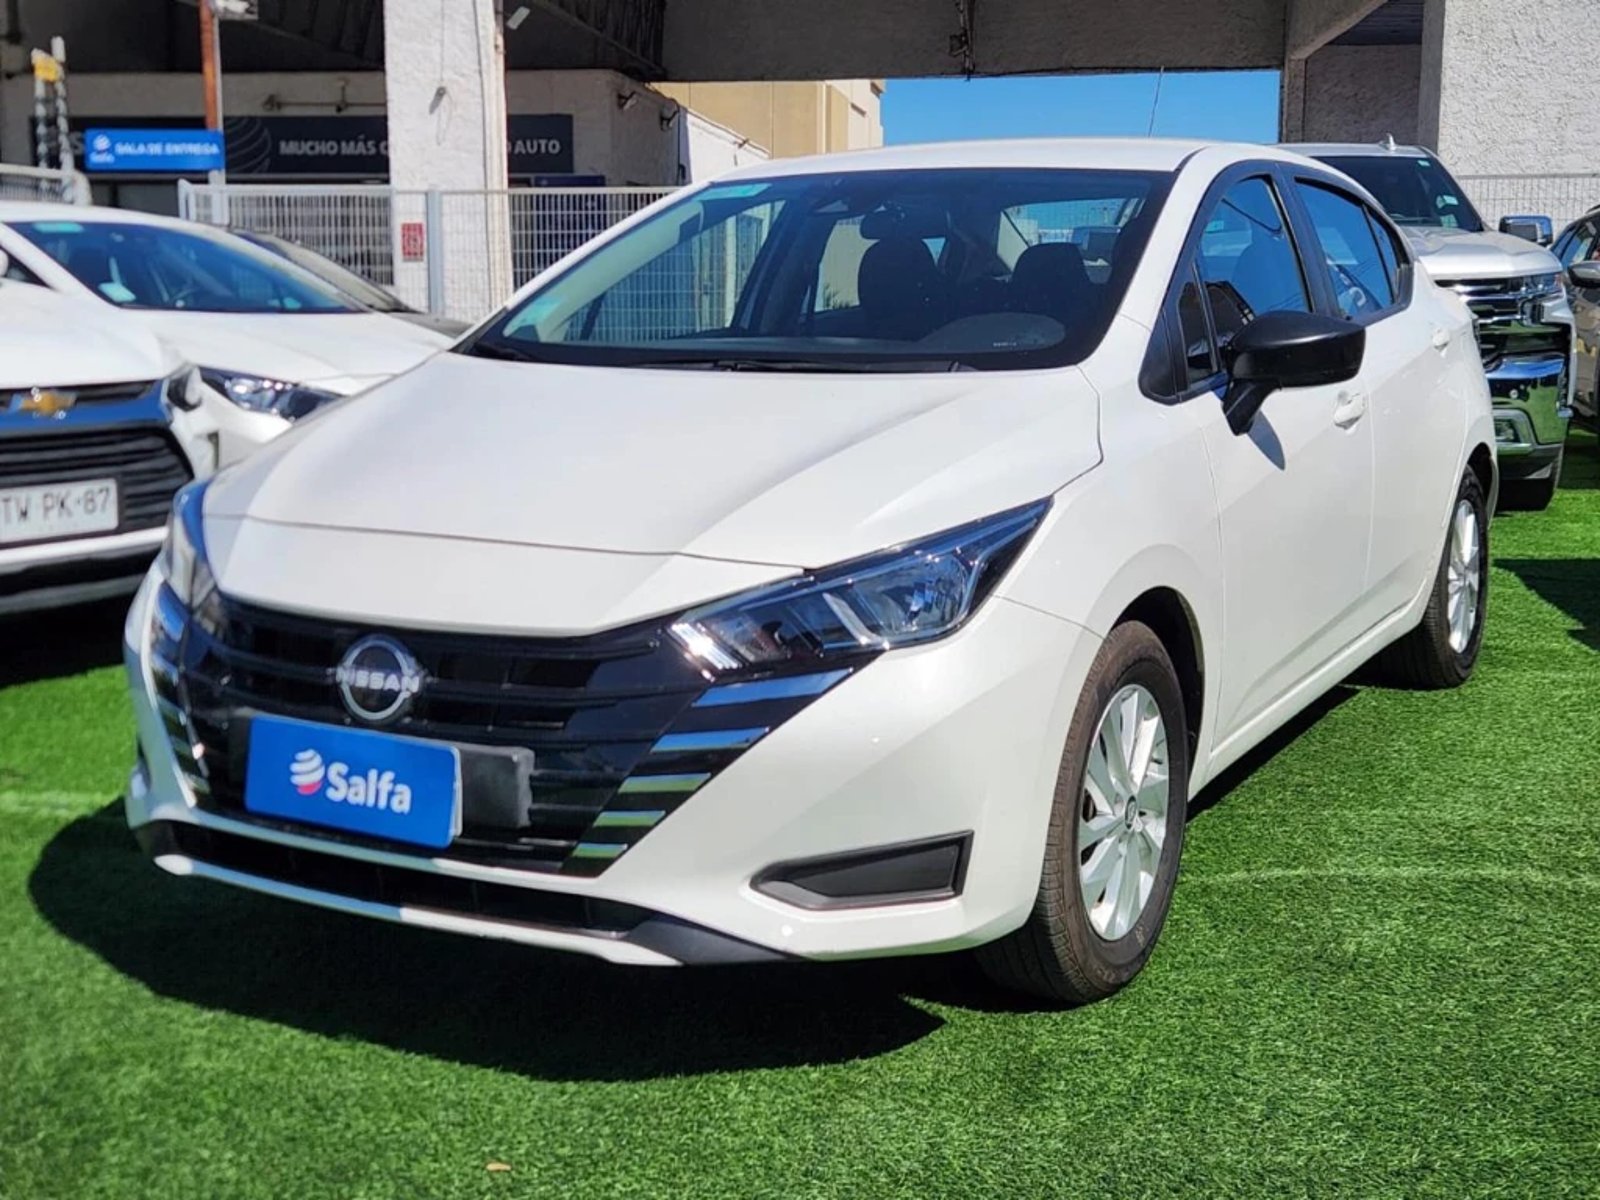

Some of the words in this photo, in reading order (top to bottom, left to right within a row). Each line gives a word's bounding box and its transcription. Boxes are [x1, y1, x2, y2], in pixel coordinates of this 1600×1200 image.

[279, 140, 339, 155] MUCHO
[341, 134, 377, 155] MÁS
[514, 139, 561, 154] AUTO
[336, 667, 420, 693] NISSAN
[325, 761, 412, 814] Salfa
